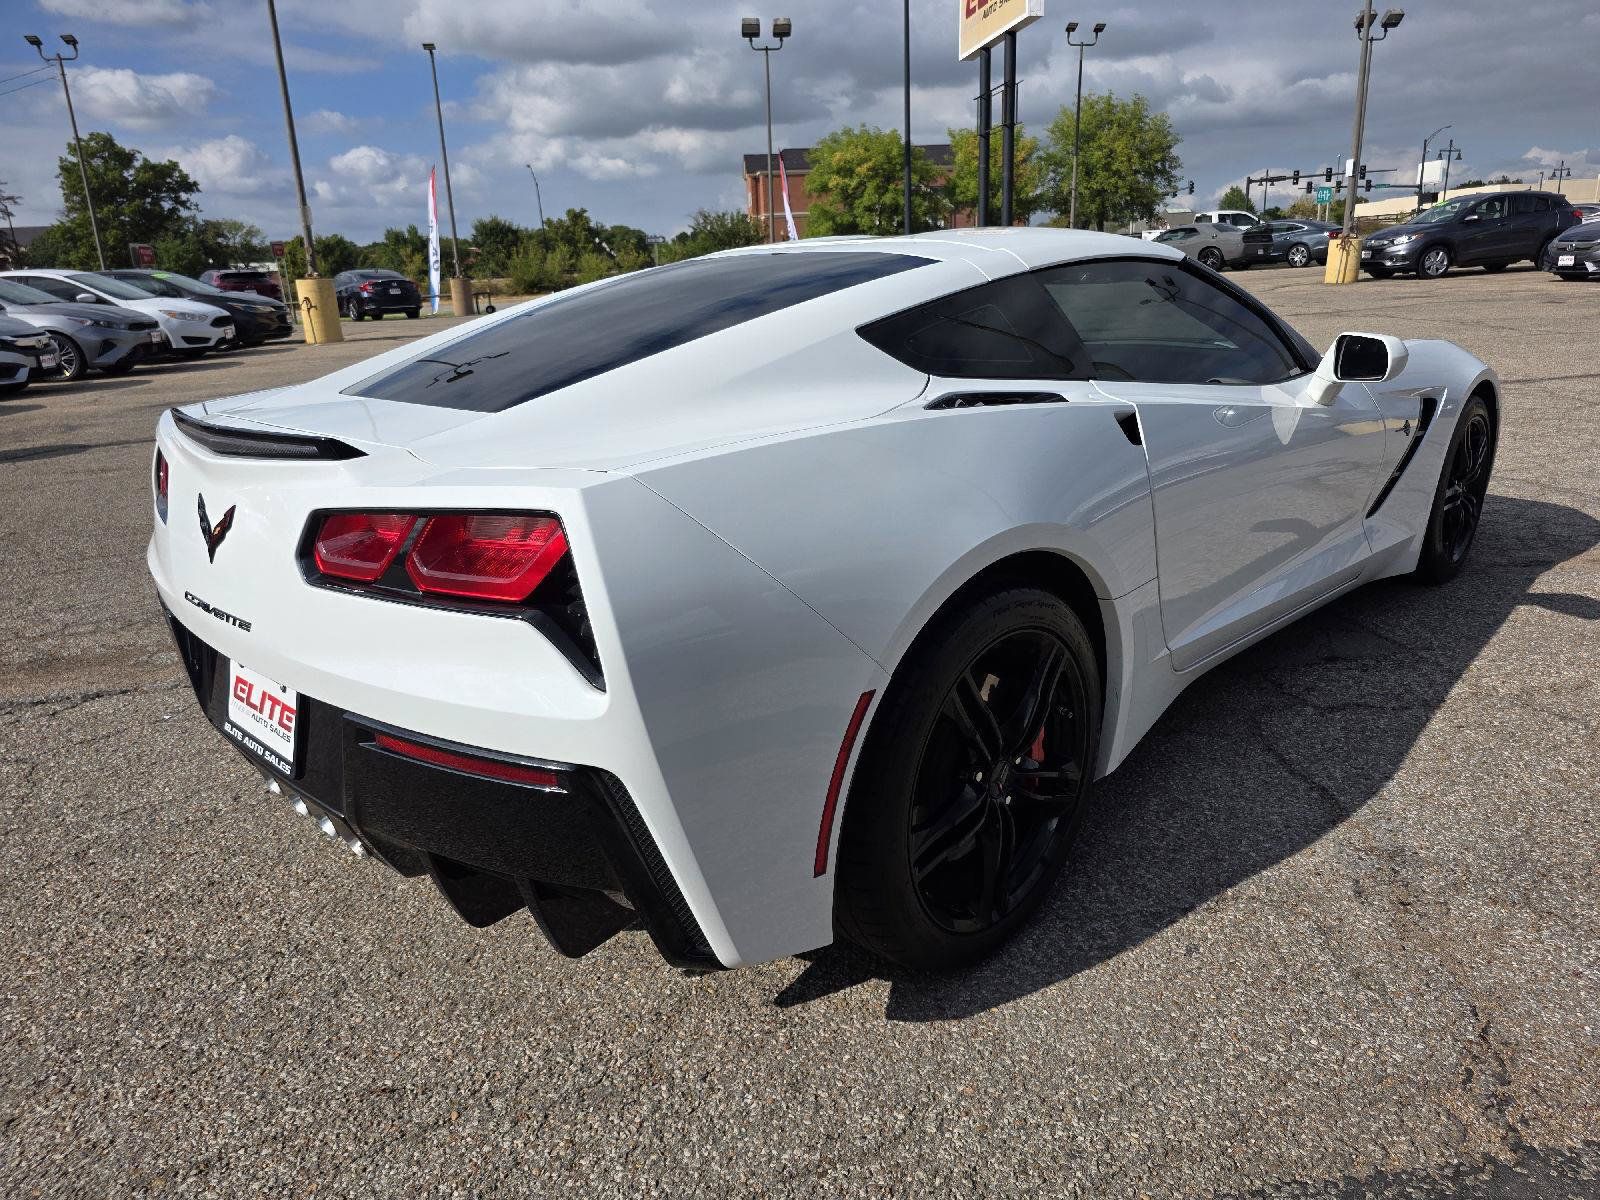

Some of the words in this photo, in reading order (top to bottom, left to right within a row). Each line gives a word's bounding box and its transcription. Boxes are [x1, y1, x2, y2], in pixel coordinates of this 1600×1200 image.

[184, 590, 252, 632] CORVETTE
[233, 675, 296, 733] ELITE
[250, 711, 268, 729] AUTO
[269, 723, 292, 744] SALES
[224, 721, 243, 741] ELITE
[243, 737, 264, 756] AUTO
[264, 750, 292, 775] SALES
